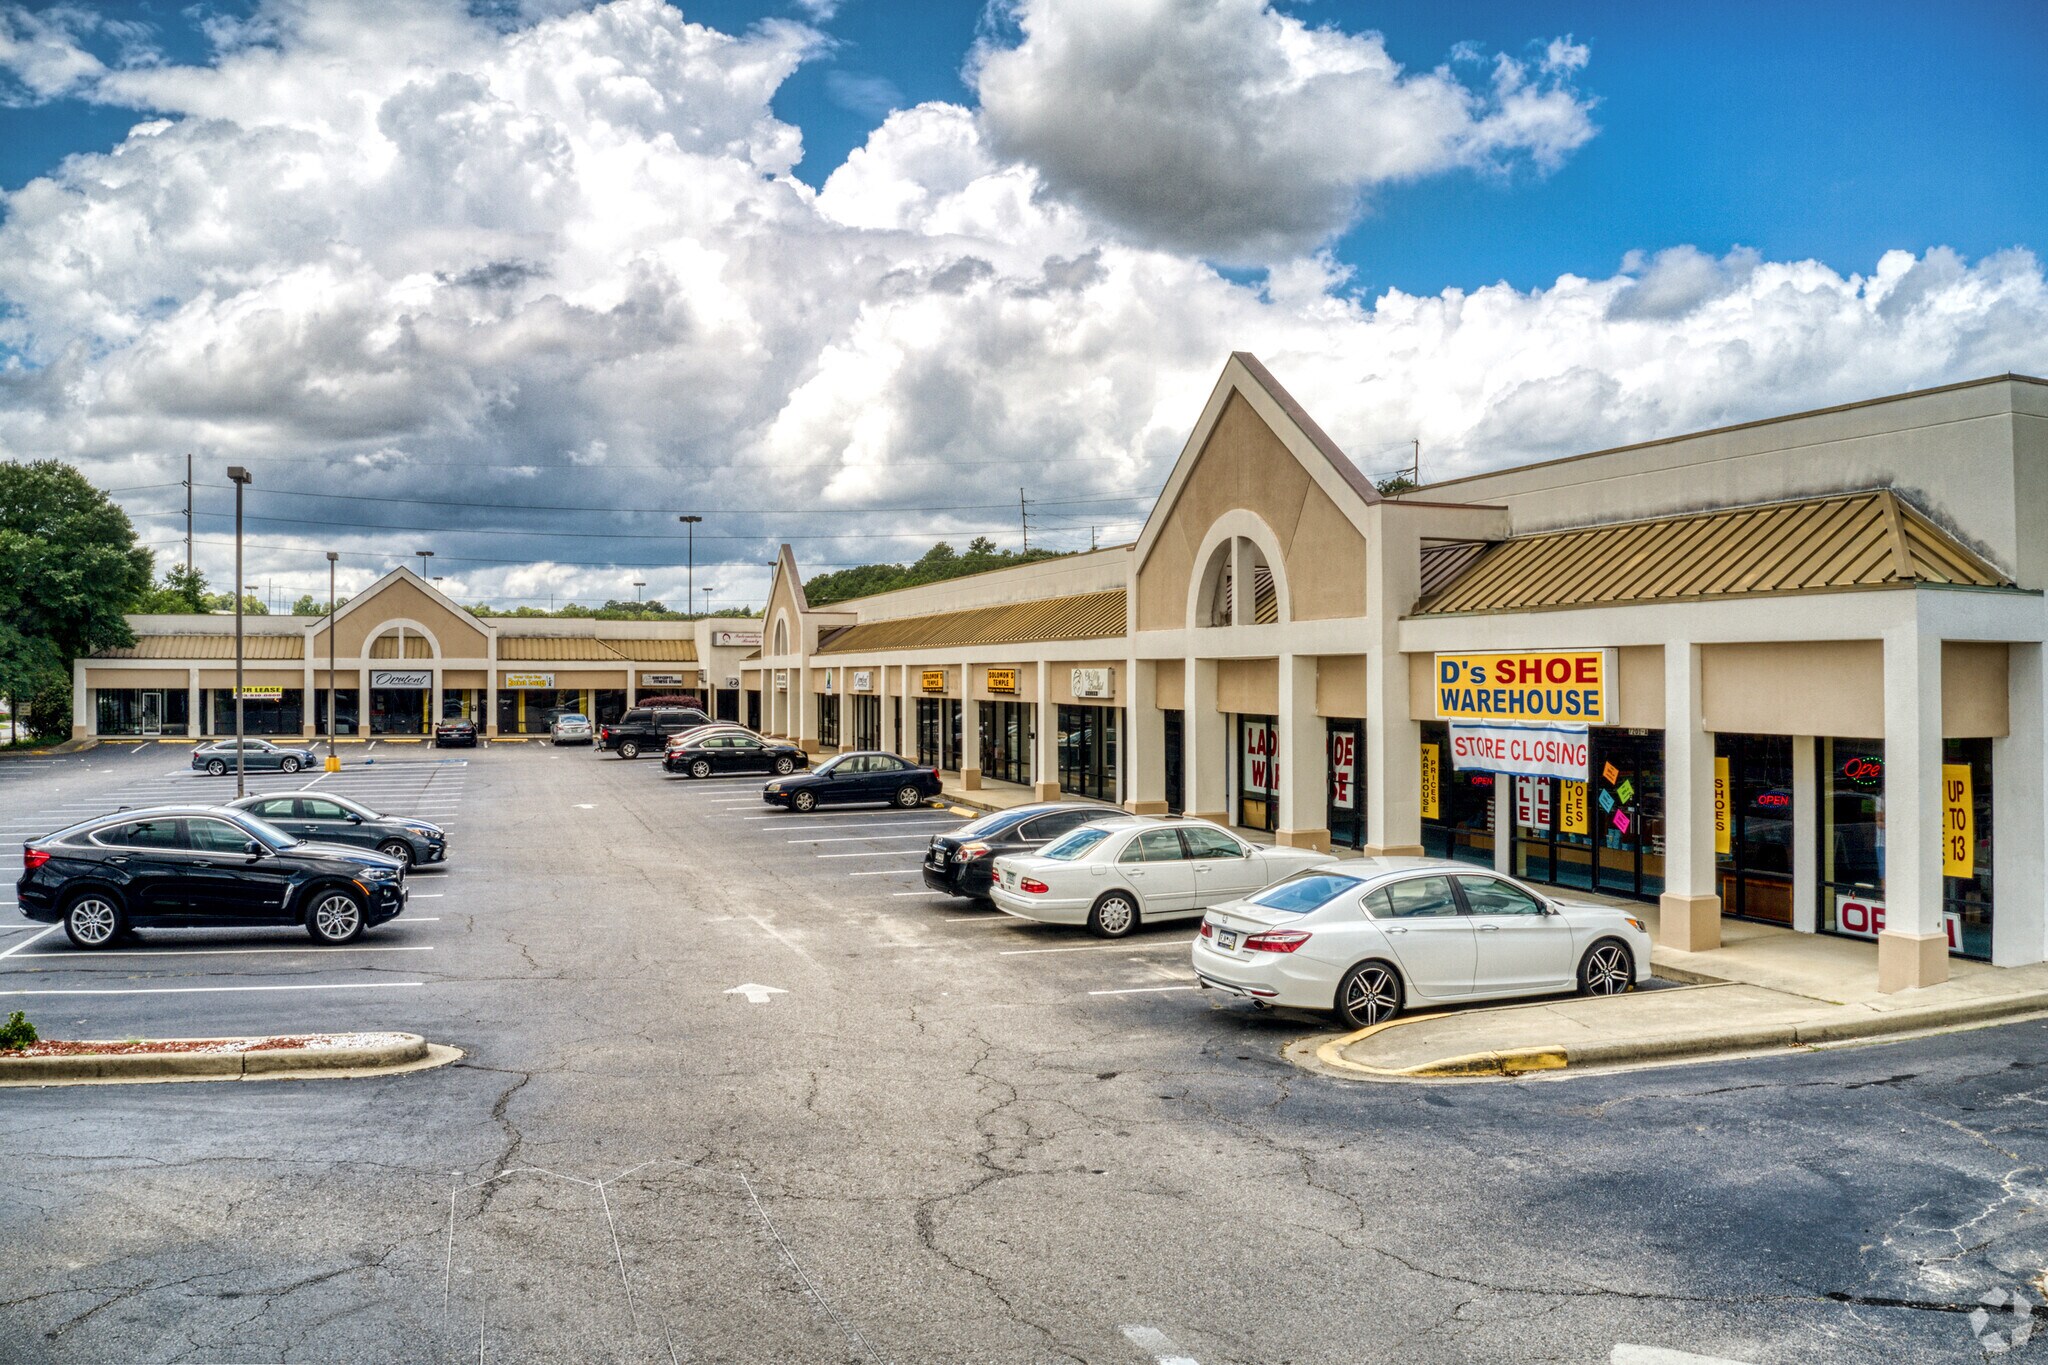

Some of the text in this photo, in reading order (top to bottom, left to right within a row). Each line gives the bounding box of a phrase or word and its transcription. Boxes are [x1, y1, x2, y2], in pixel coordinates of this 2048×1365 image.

[376, 673, 426, 685] Opulent
[988, 671, 1014, 679] SOLOMON'S
[1441, 658, 1598, 684] D's SHOE
[993, 679, 1009, 687] TEMPLE
[1441, 688, 1600, 716] WAREHOUSE
[1455, 736, 1587, 767] STORE CLOSING
[1844, 758, 1881, 778] Ope
[1421, 748, 1430, 813] WAREHOUSE
[1471, 776, 1493, 785] OPEN
[1947, 780, 1964, 802] UP
[1714, 779, 1725, 832] SHOES
[1758, 795, 1789, 806] OPEN
[1949, 808, 1966, 831] TO
[1951, 835, 1966, 861] 13
